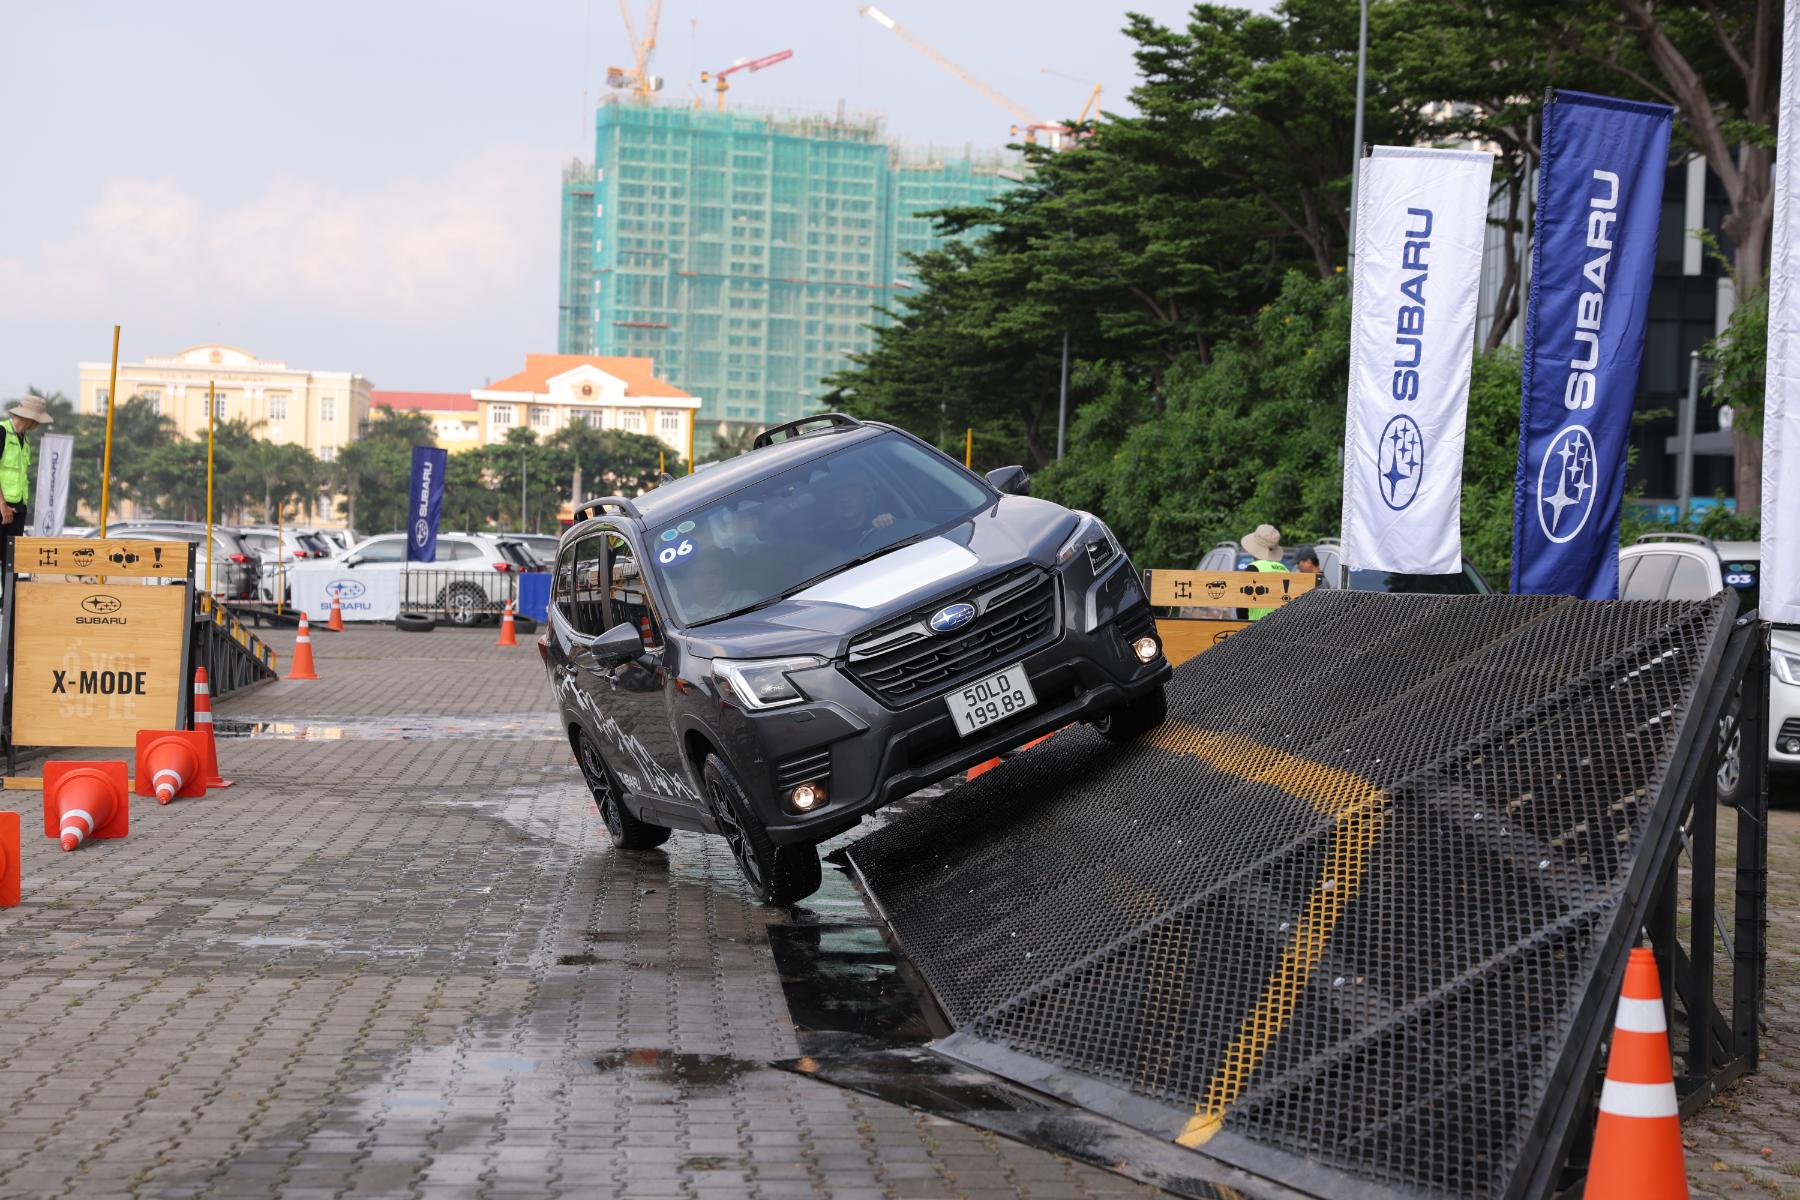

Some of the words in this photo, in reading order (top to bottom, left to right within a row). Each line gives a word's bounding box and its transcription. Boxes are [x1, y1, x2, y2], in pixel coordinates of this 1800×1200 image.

[1392, 207, 1434, 402] SUBARU
[1566, 169, 1620, 410] SUBARU
[419, 461, 433, 518] SUBARU
[659, 539, 693, 564] 06
[1727, 574, 1752, 584] 03
[75, 616, 127, 625] SUBARU
[51, 670, 147, 696] X-MODE
[963, 674, 1011, 707] 50LD
[965, 689, 1026, 729] 199.89
